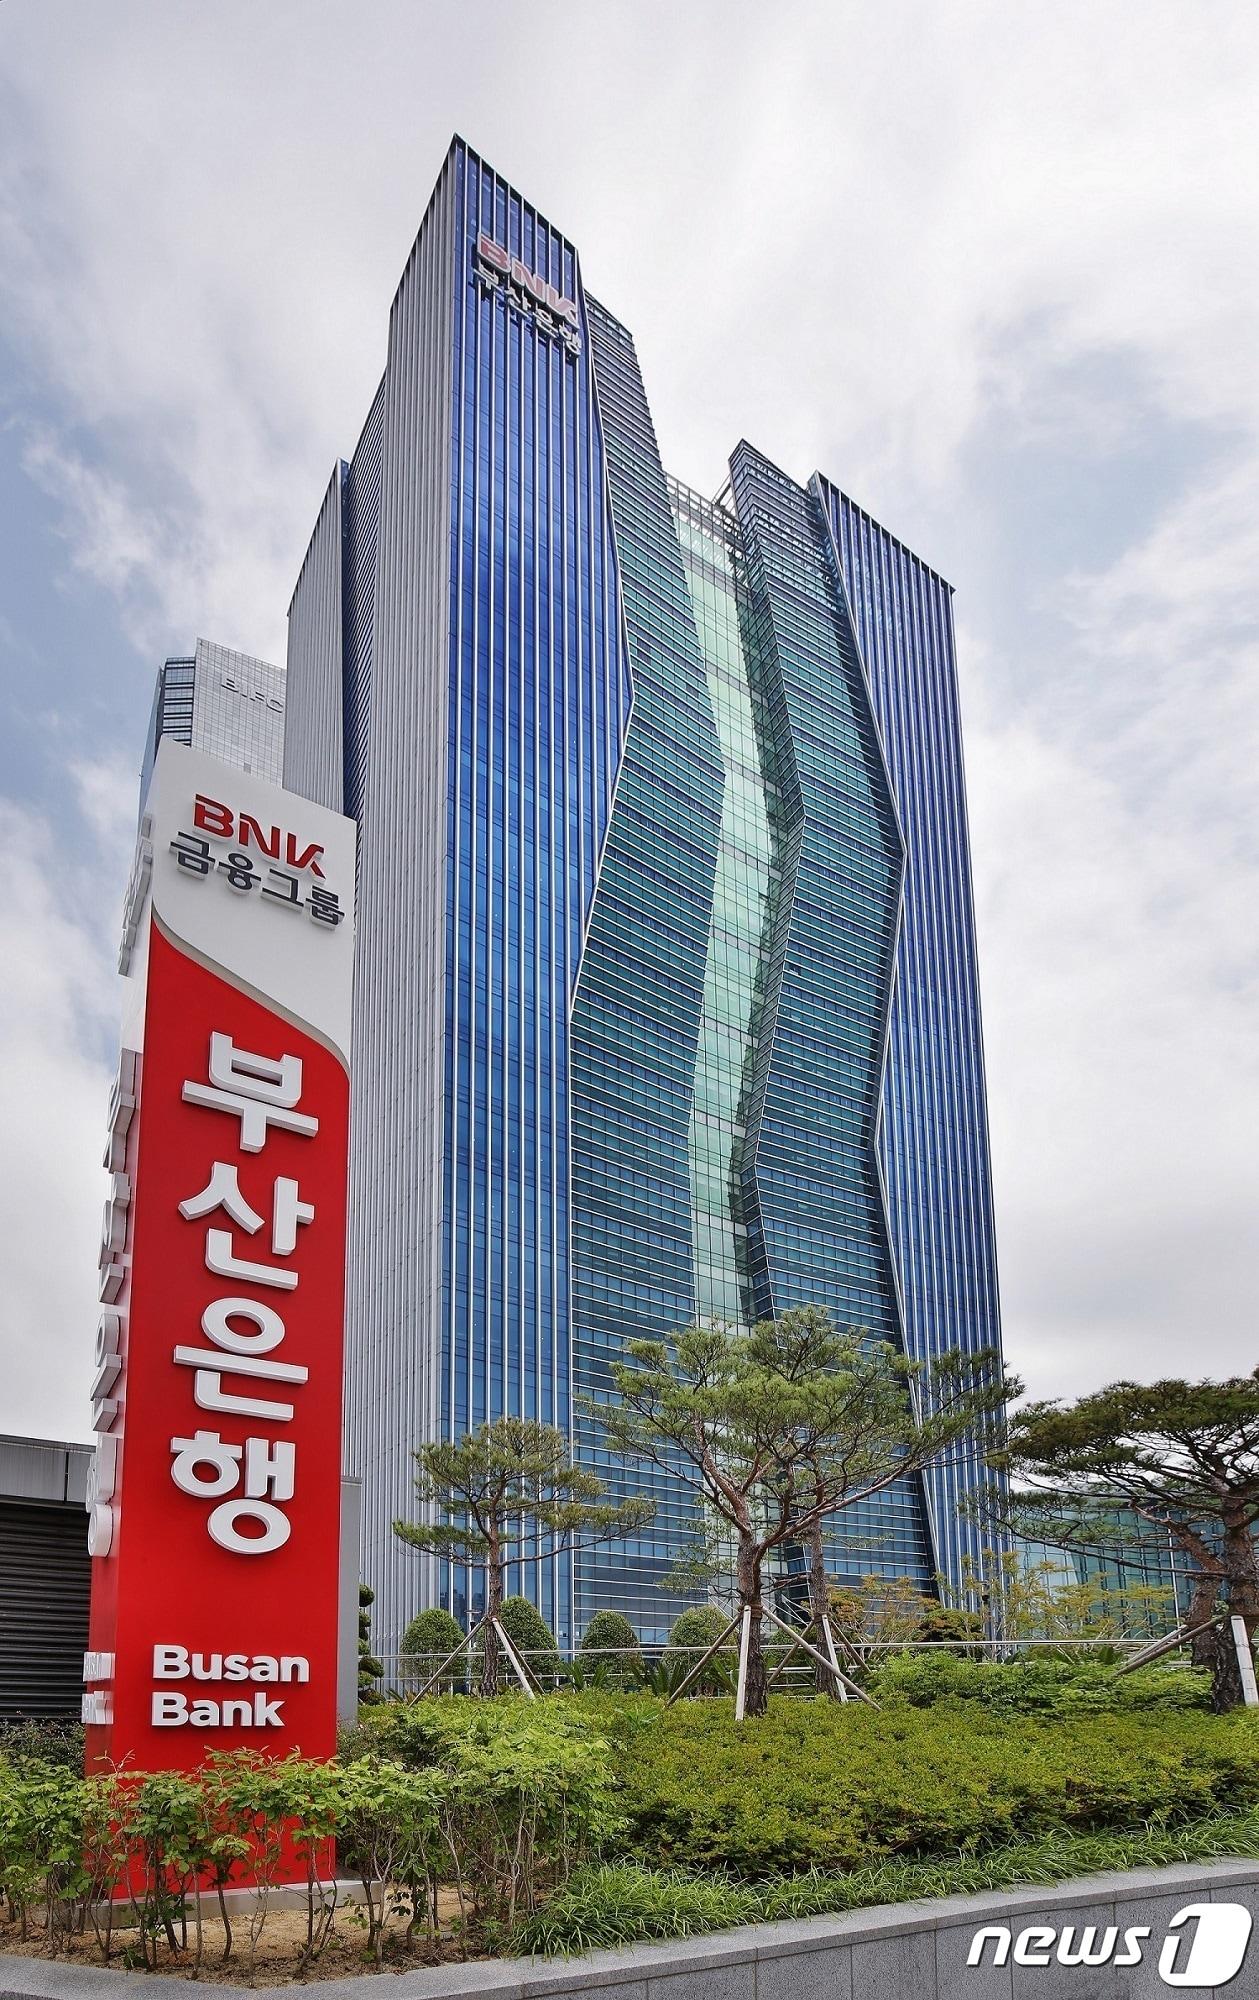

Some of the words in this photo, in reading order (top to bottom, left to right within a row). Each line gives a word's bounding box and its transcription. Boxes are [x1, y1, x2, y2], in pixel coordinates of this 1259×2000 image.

[476, 231, 580, 330] BNK
[169, 831, 345, 928] 금융그룹
[193, 793, 327, 880] BNK
[170, 1030, 320, 1555] 부산은행
[151, 1691, 286, 1728] Bank
[152, 1644, 310, 1683] Busan
